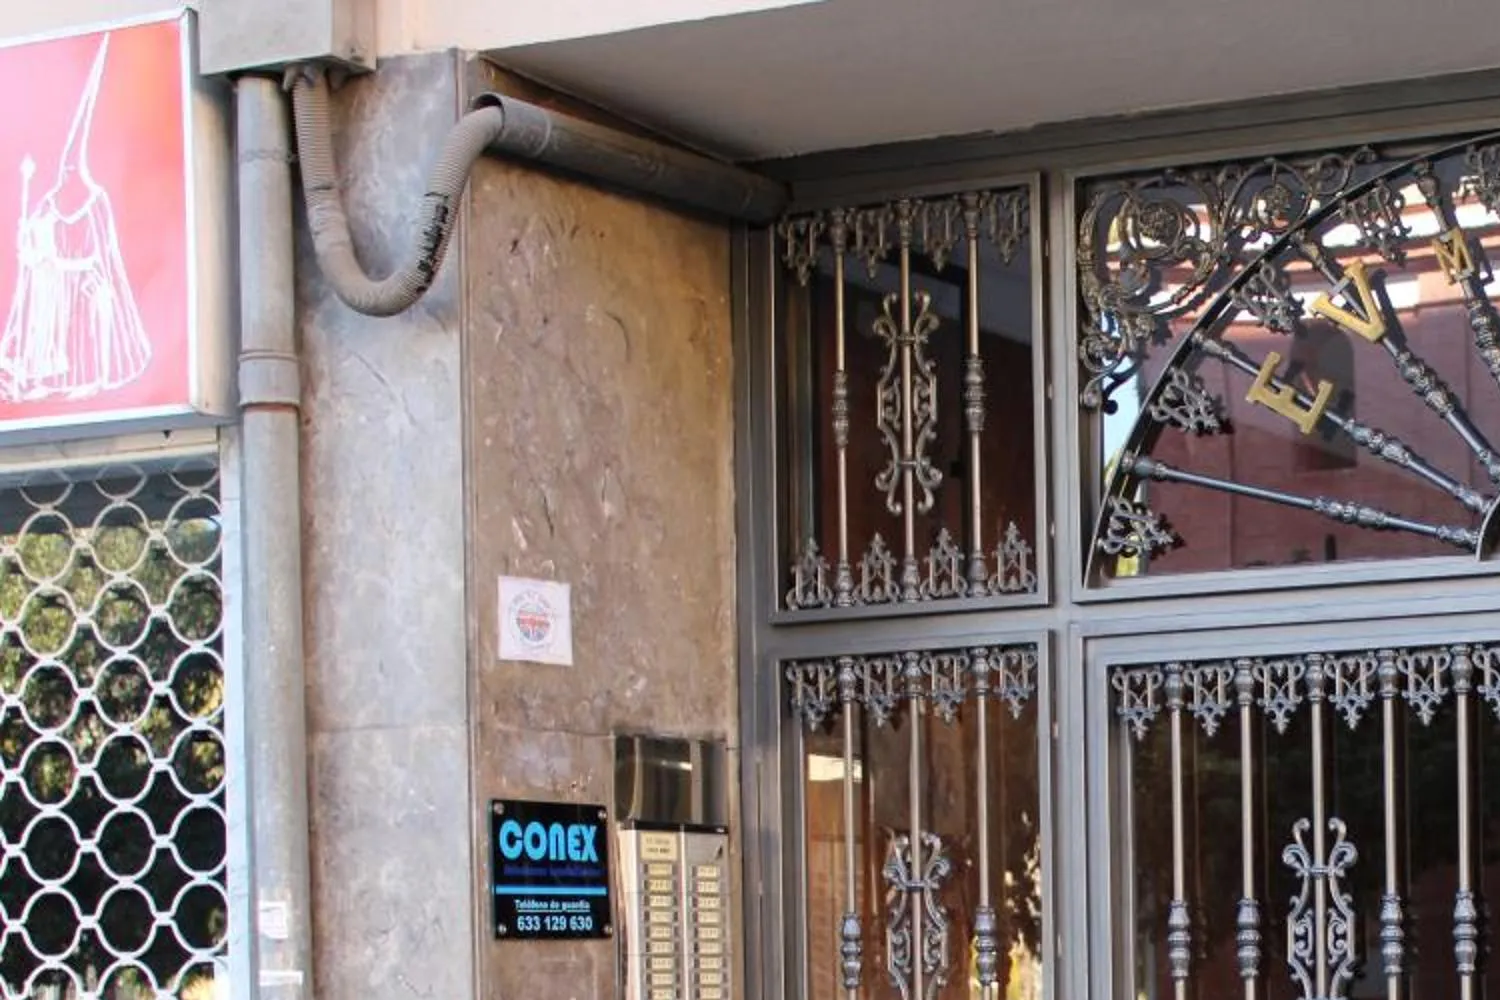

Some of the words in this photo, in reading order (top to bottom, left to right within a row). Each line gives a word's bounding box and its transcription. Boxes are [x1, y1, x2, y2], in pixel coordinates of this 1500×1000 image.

[517, 915, 541, 931] 633
[543, 915, 567, 931] 129
[569, 915, 593, 931] 630
